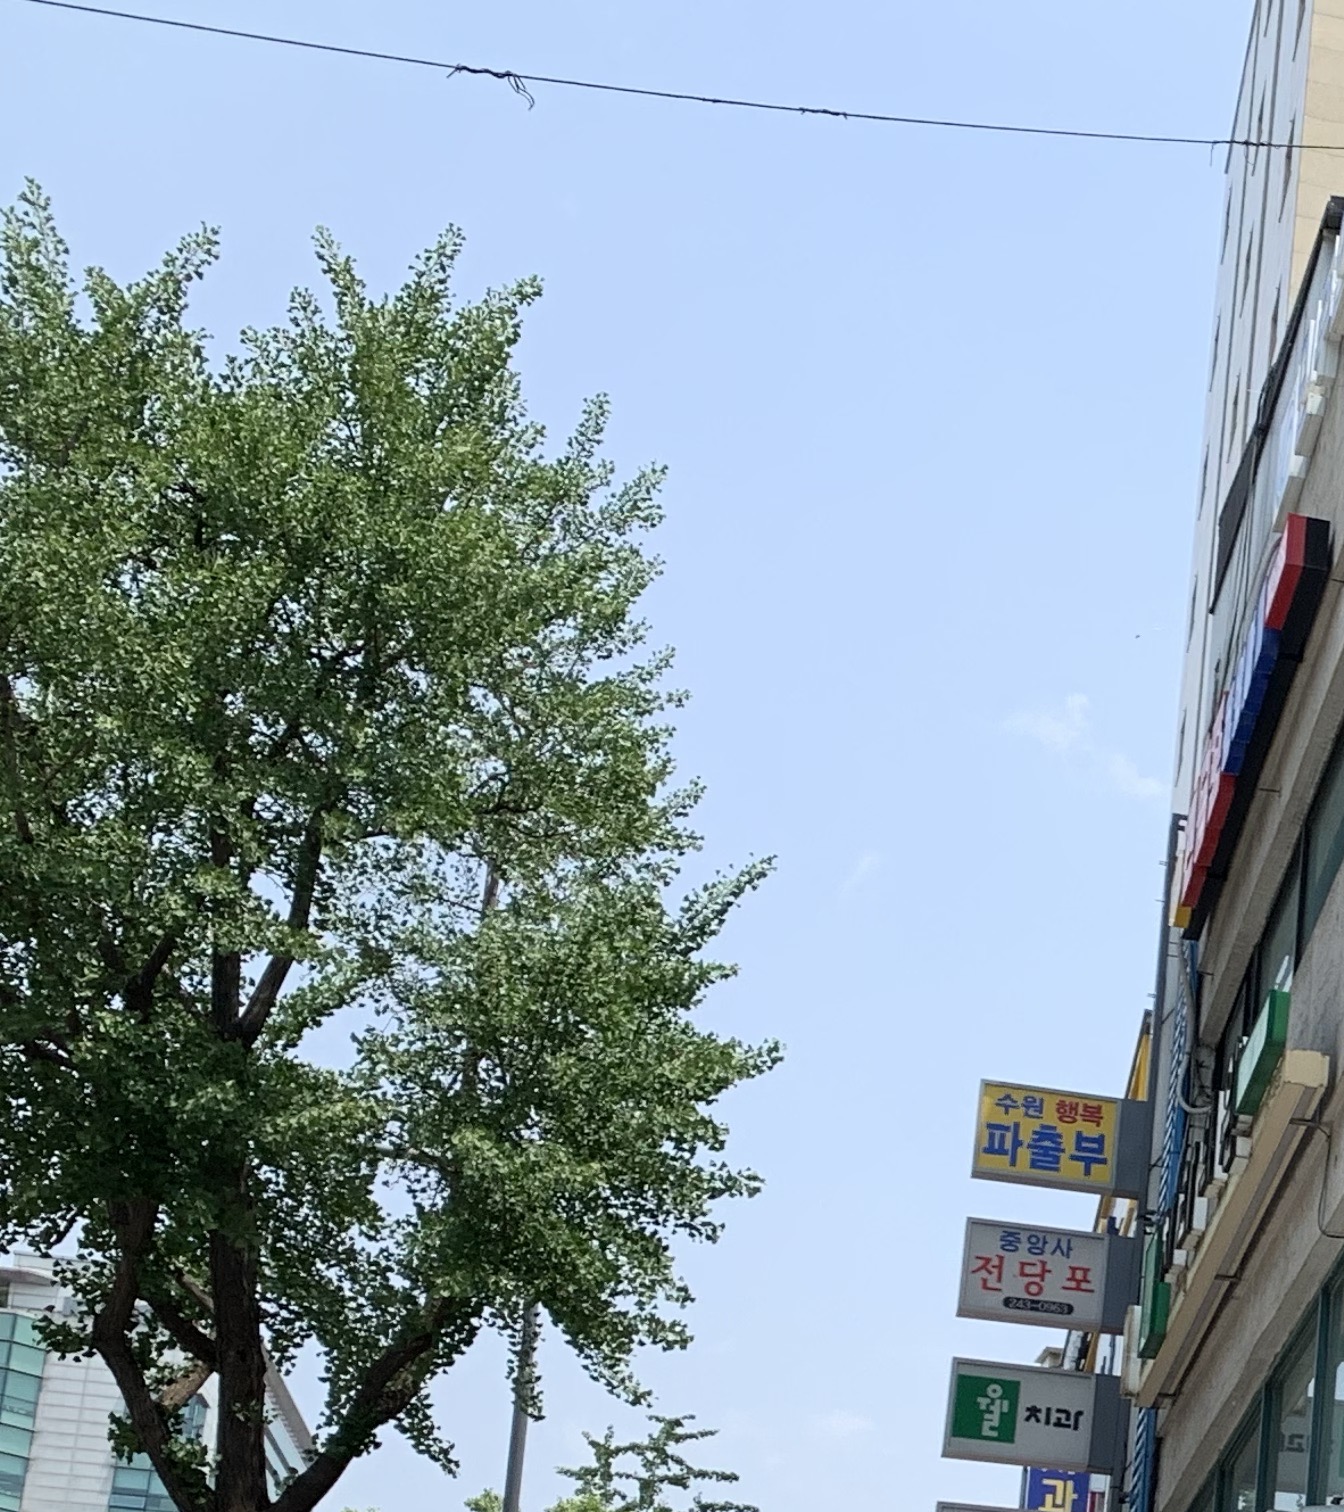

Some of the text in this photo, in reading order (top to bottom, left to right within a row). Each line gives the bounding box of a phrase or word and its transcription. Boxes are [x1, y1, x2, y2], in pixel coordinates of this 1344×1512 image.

[994, 1094, 1104, 1127] 수원 행복
[982, 1120, 1108, 1177] 파출부
[999, 1230, 1074, 1259] 중앙사
[971, 1254, 1096, 1297] 전당포
